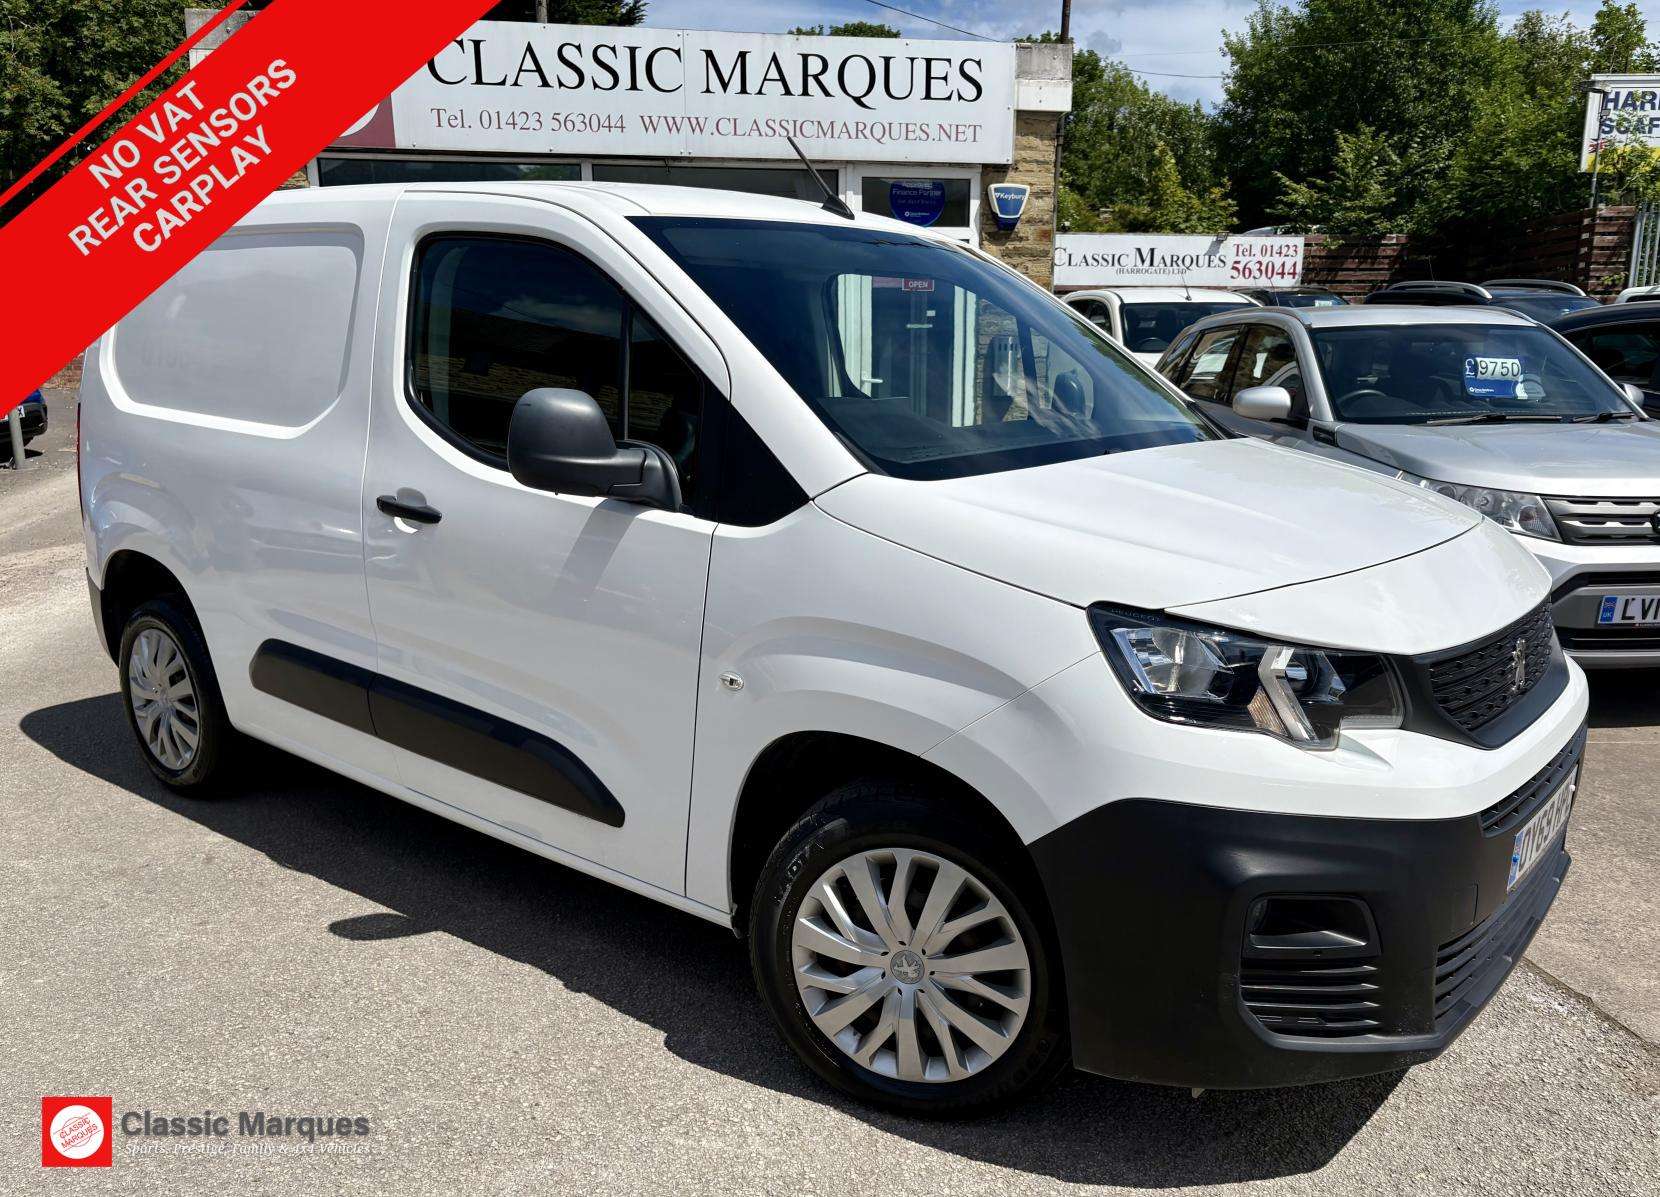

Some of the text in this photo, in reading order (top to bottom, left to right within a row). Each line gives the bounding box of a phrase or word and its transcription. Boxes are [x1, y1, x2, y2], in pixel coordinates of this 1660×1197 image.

[427, 38, 983, 110] CLASSIC MARQUES
[1602, 91, 1660, 111] HAR
[430, 108, 983, 144] Tel. 01423 563044 WWW.CLASSICMARQUES.NET
[1233, 243, 1298, 257] Tel. 01423
[1230, 261, 1297, 280] 563044
